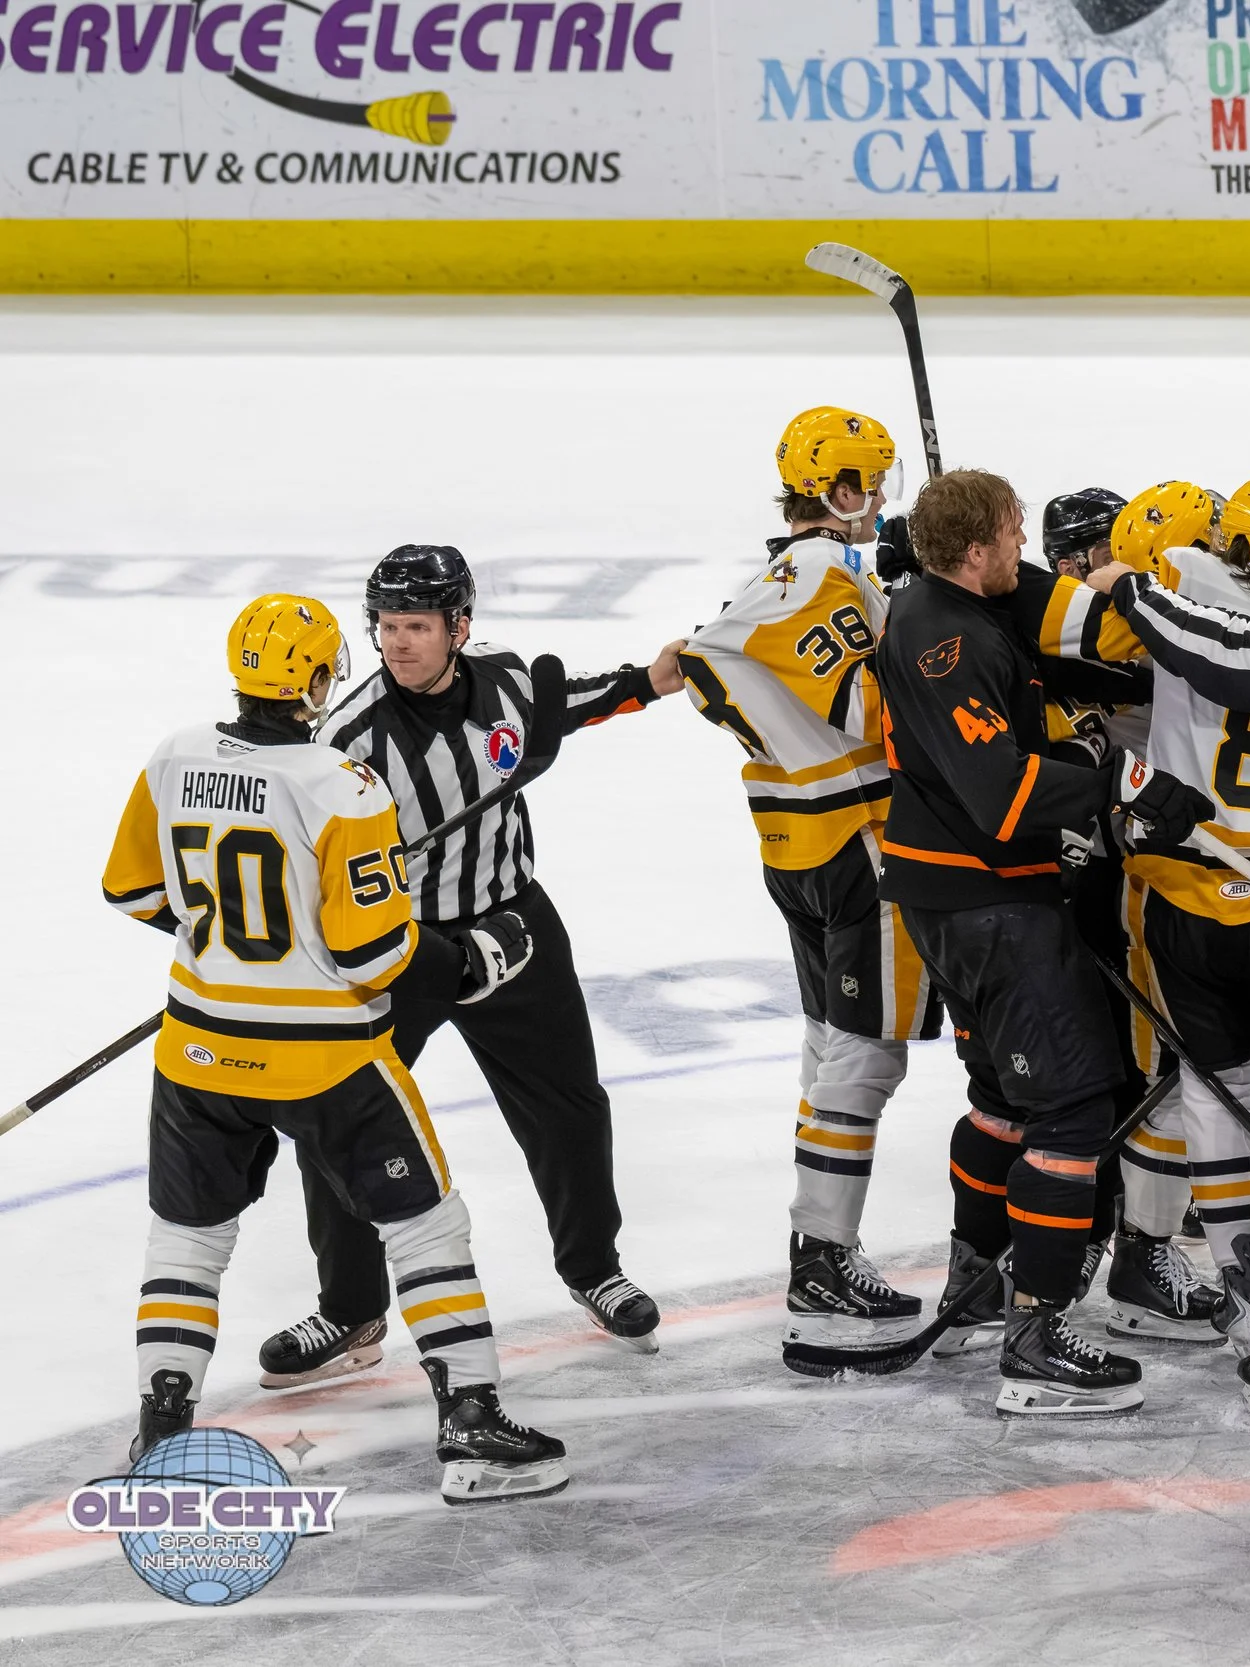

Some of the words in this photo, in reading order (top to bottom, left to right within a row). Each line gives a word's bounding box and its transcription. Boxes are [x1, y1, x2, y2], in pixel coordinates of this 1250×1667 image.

[0, 3, 287, 74] ERVICE
[314, 0, 682, 79] ELECTRIC
[872, 0, 1027, 47] THE
[758, 57, 1146, 123] MORNING
[27, 152, 148, 184] CABLE
[159, 152, 208, 184] TV
[216, 152, 244, 184] &
[254, 152, 622, 184] COMMUNICATIONS
[853, 129, 1060, 193] CALL
[242, 649, 260, 670] 50
[796, 603, 876, 679] 38
[495, 721, 520, 733] OCKEY
[182, 771, 267, 815] HARDING
[171, 823, 295, 964] 50
[347, 845, 412, 909] 50
[1228, 884, 1249, 895] AHL
[190, 1049, 208, 1062] AHL
[220, 1057, 267, 1071] CCM
[805, 1280, 859, 1315] CCM
